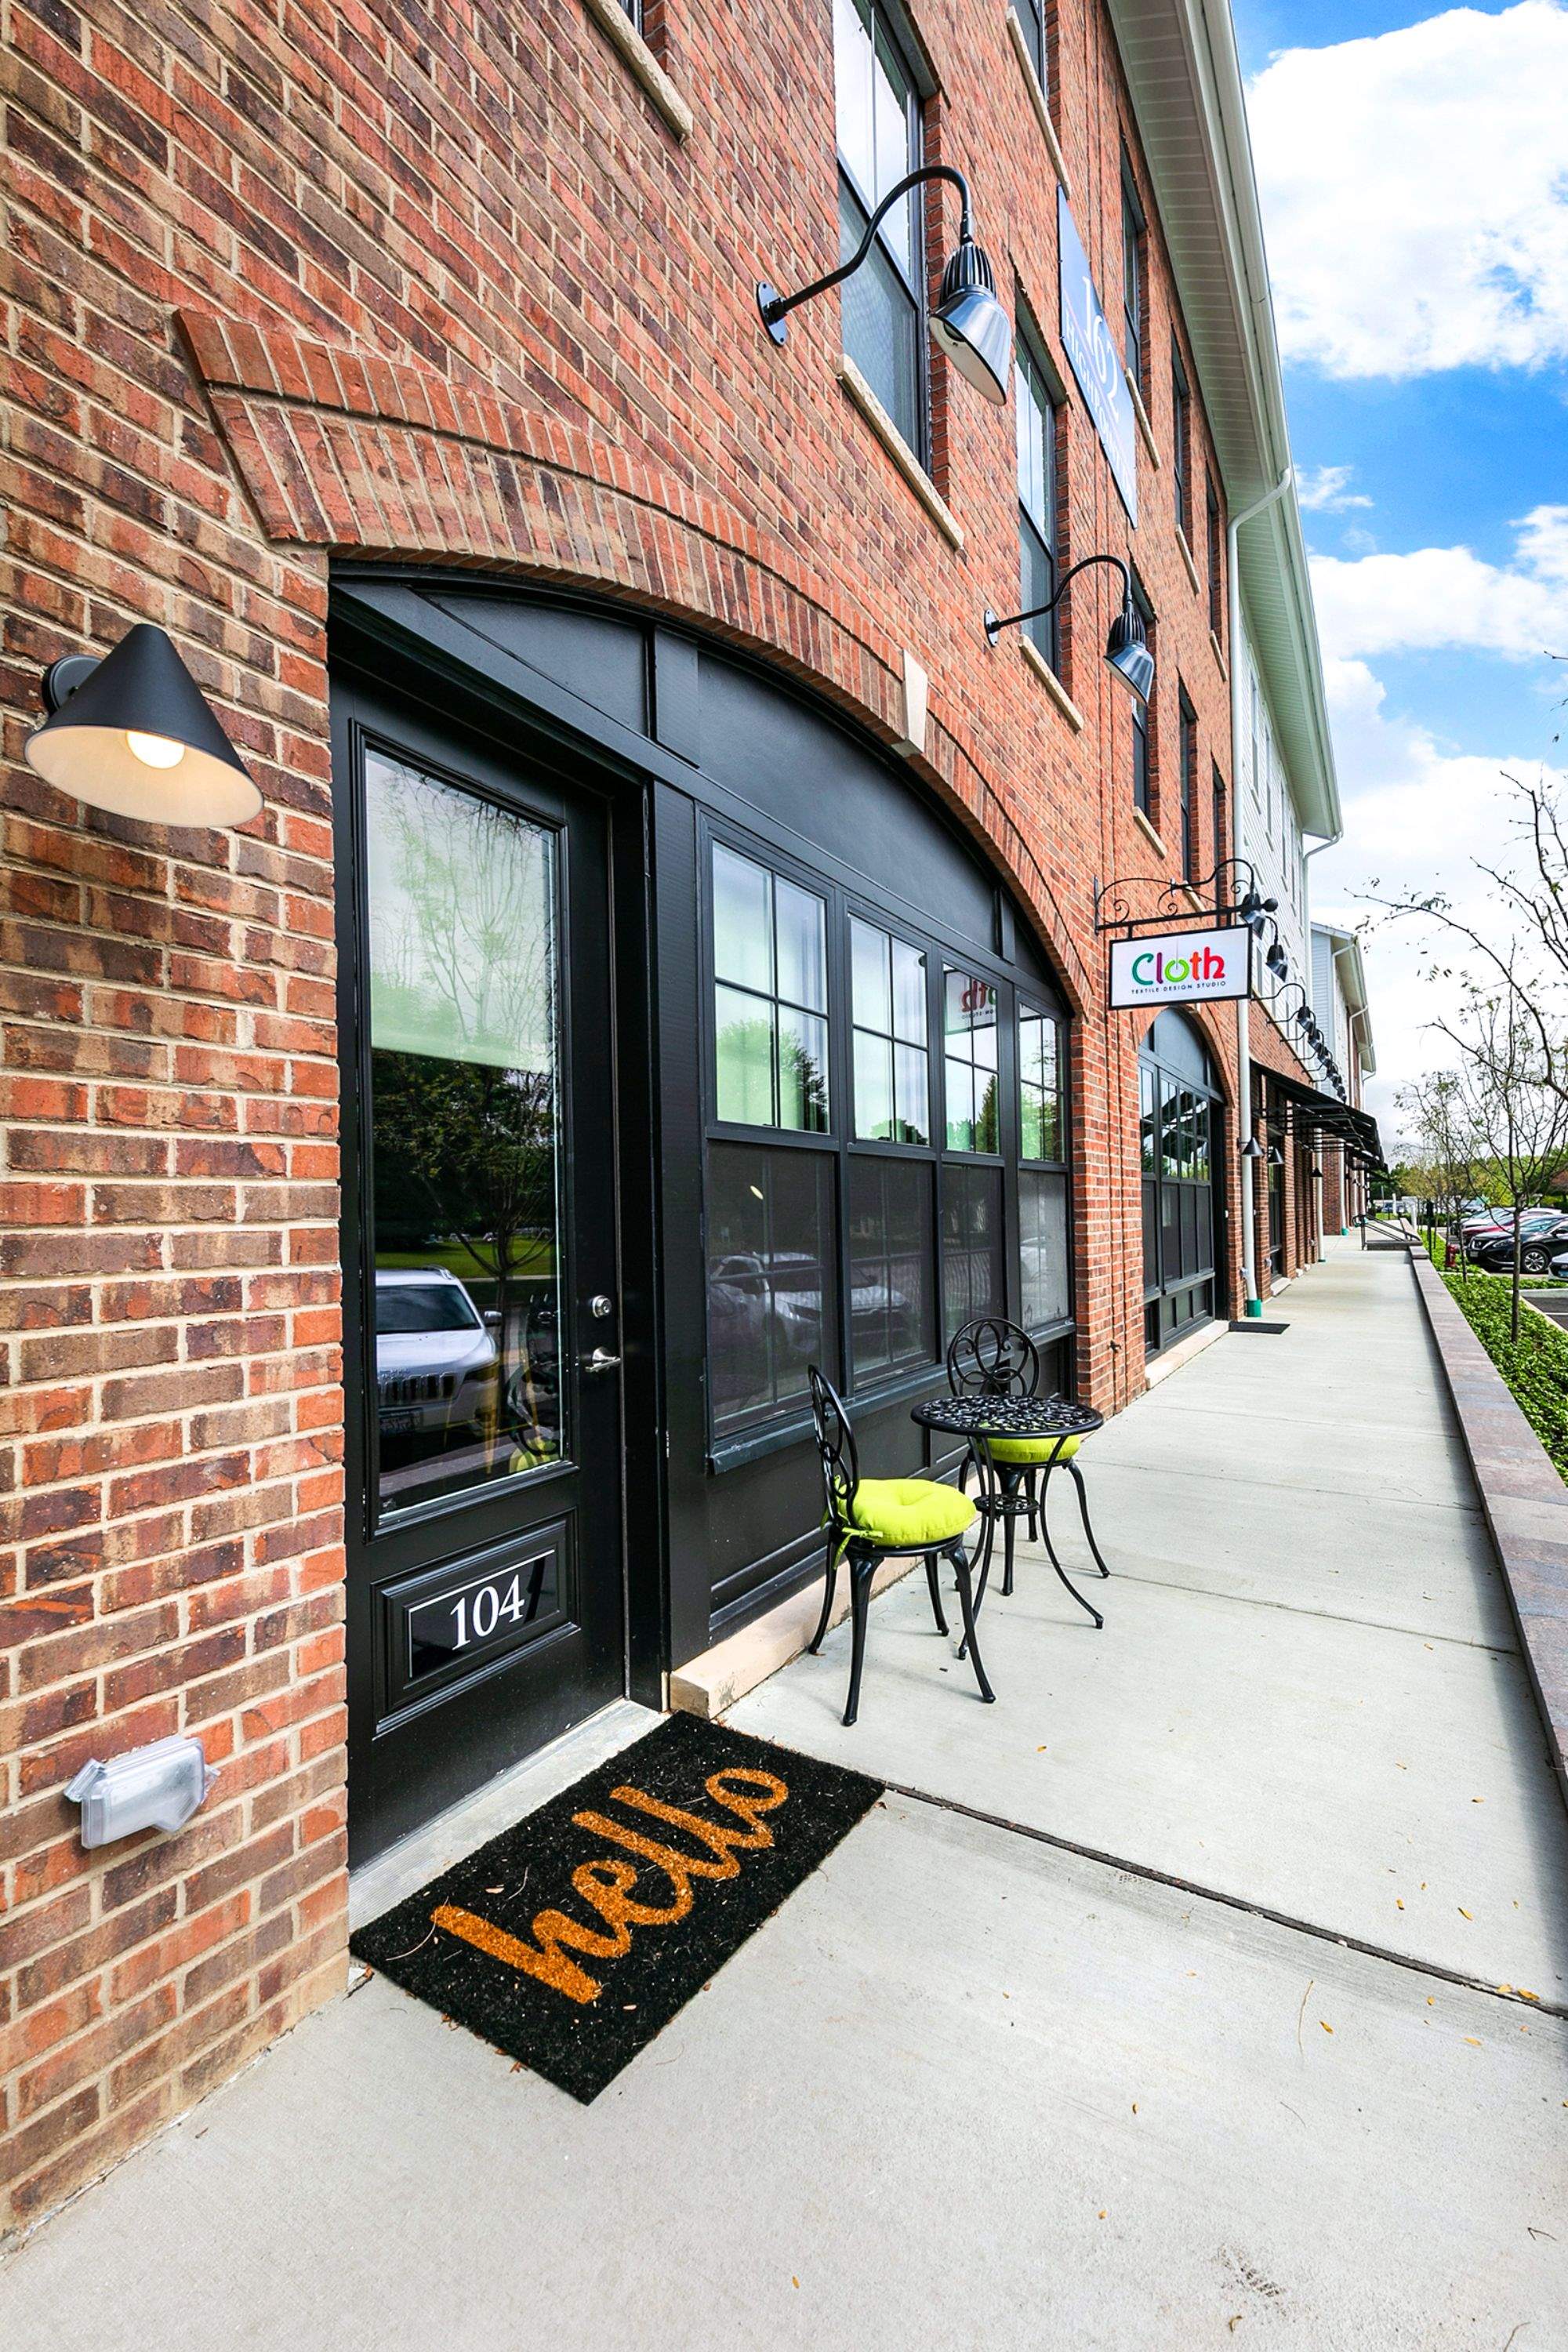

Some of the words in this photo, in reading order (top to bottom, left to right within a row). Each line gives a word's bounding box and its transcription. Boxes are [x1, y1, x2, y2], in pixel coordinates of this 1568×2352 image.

[1082, 275, 1120, 422] 162
[1131, 946, 1226, 985] Cloth
[1196, 980, 1226, 989] STUDIO
[450, 1574, 525, 1651] 104
[431, 1767, 789, 2004] hello
